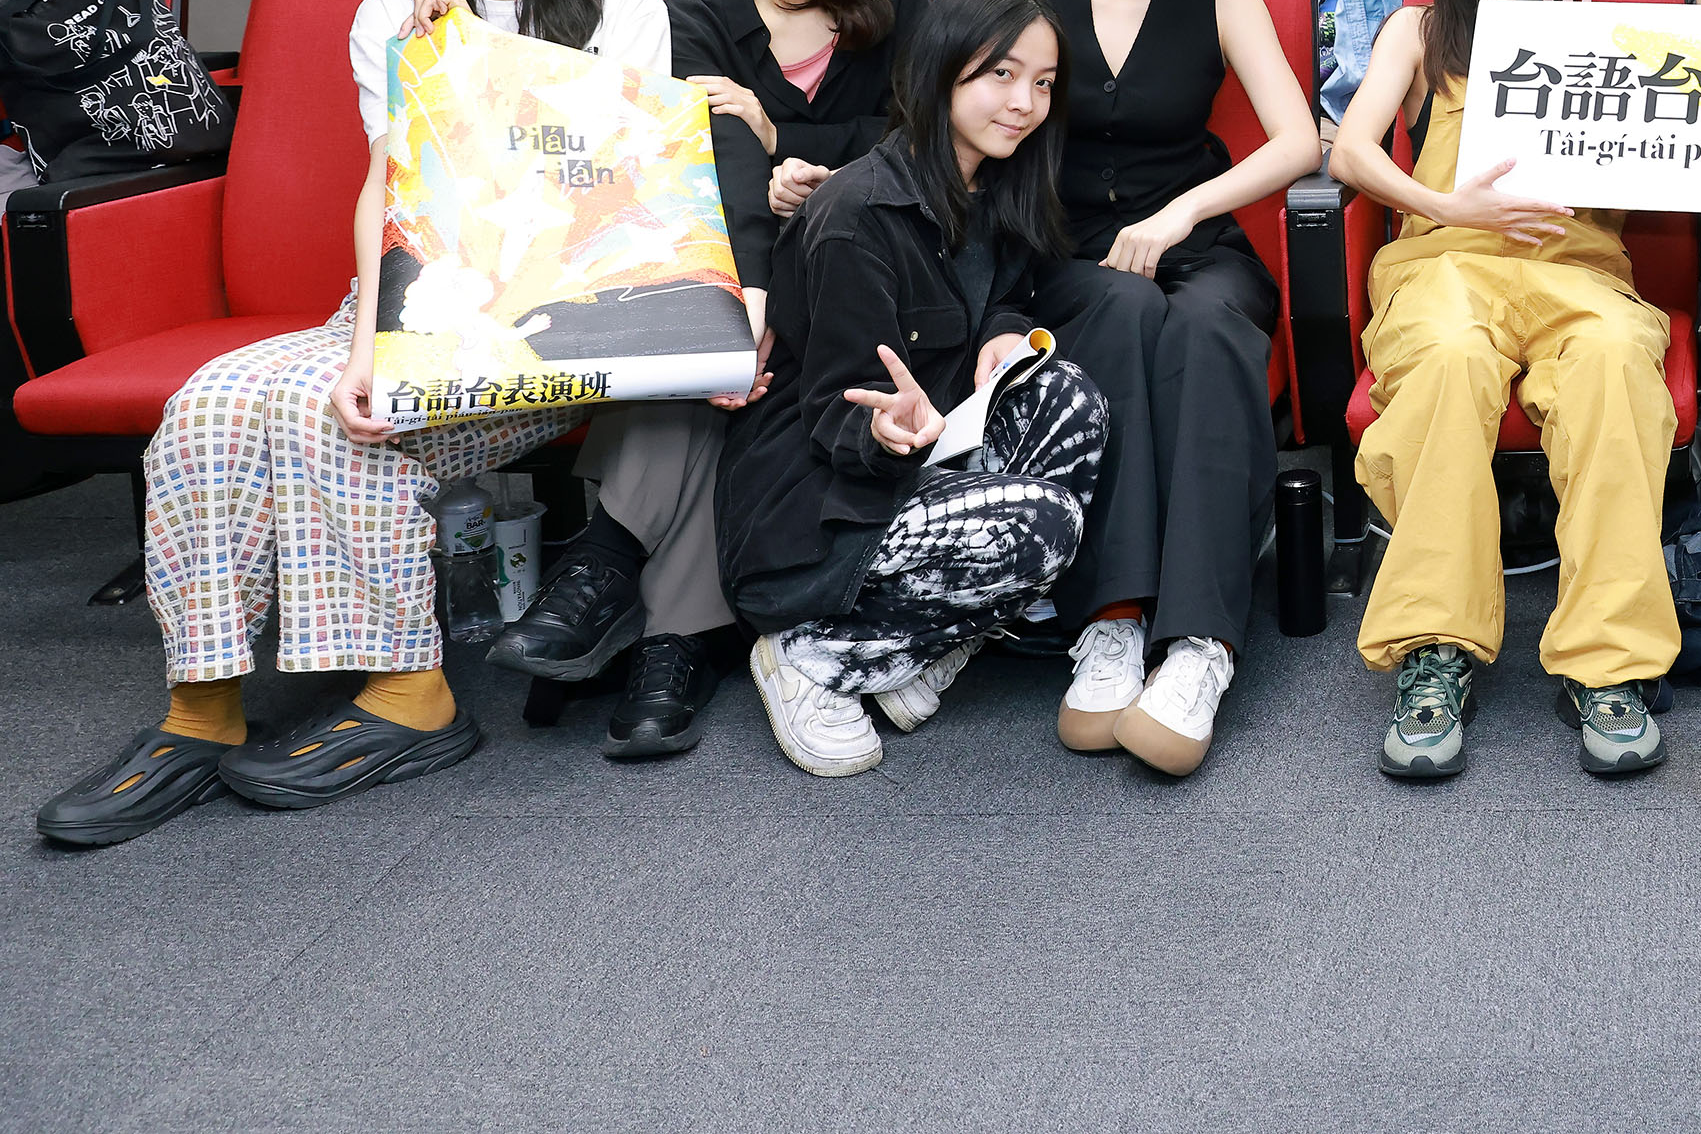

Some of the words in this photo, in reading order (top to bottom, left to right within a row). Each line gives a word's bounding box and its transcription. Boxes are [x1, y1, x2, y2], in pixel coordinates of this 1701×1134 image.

[506, 125, 586, 155] Piáu
[1540, 129, 1676, 166] Tâi-gí-tâi
[387, 371, 613, 414] 台語台表演班
